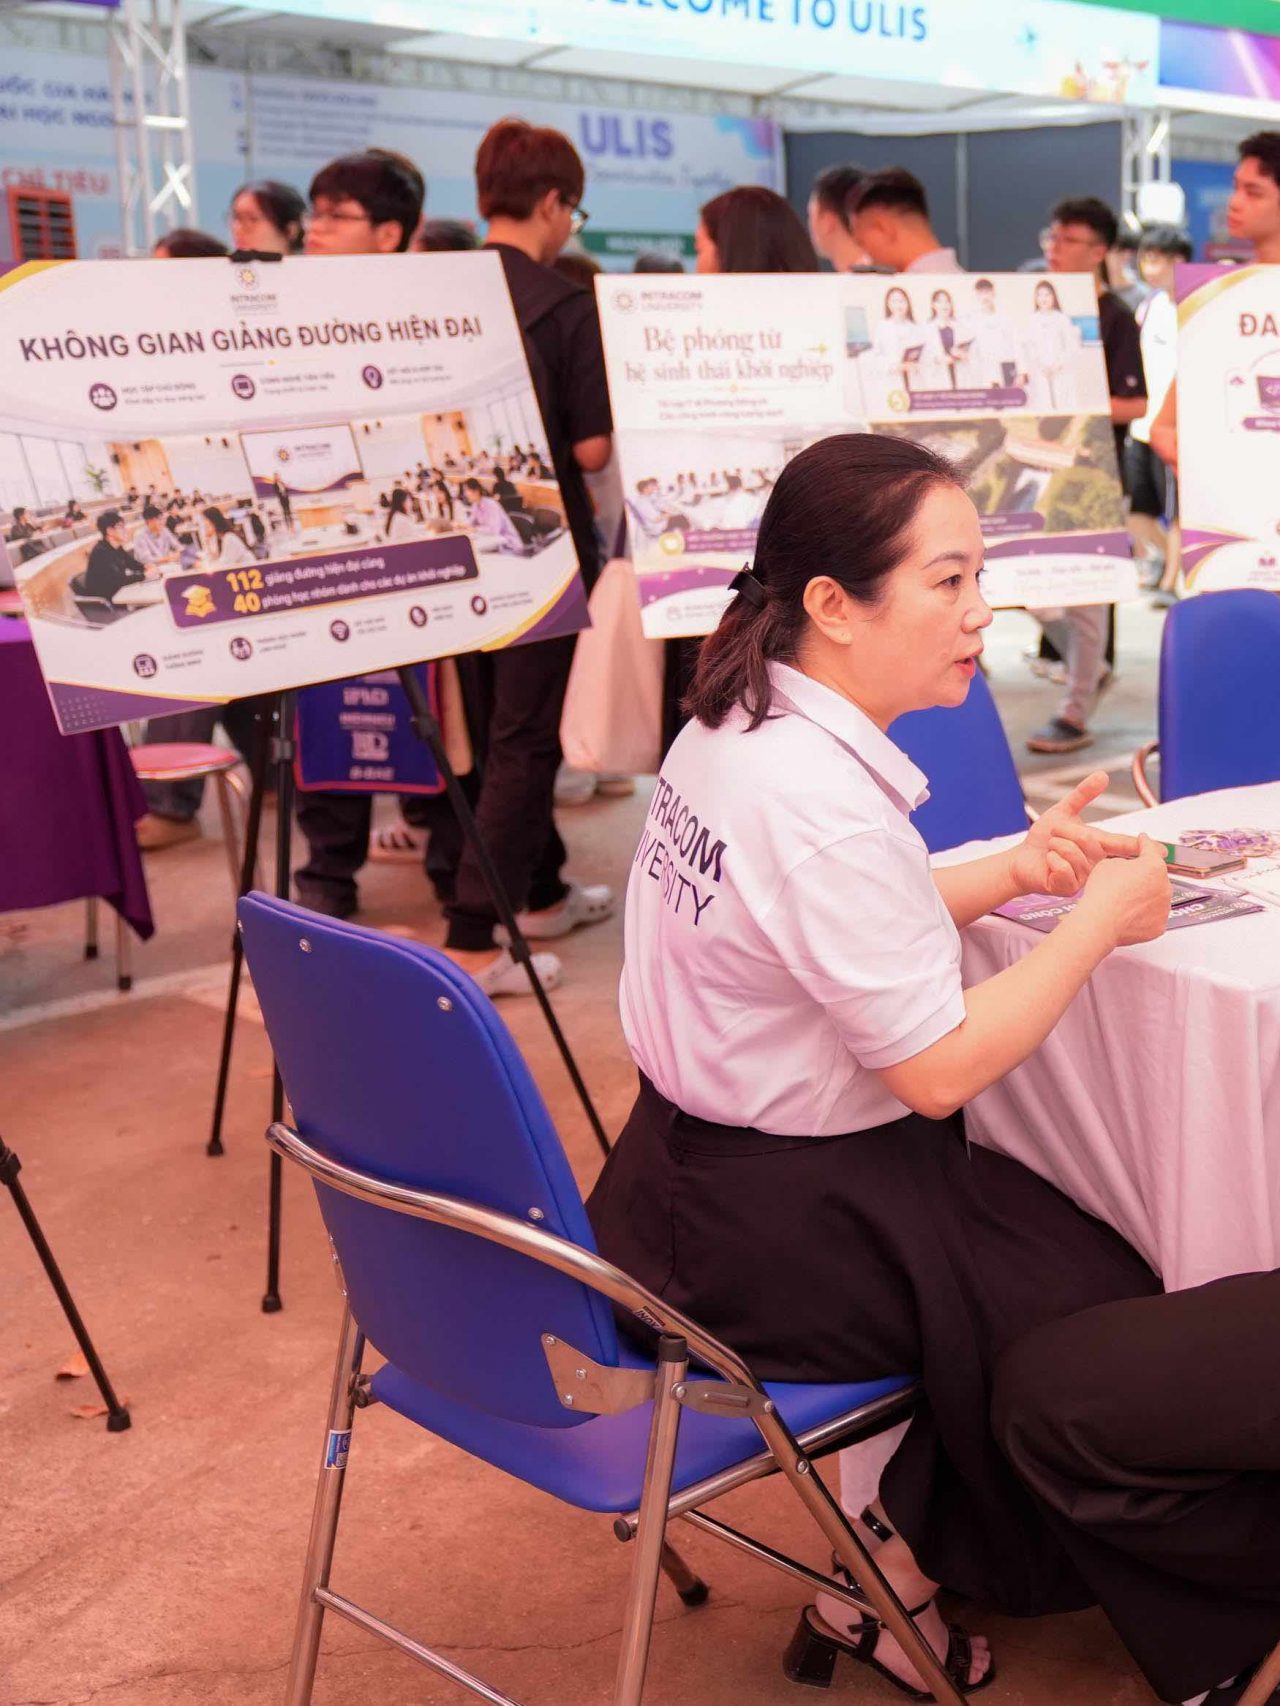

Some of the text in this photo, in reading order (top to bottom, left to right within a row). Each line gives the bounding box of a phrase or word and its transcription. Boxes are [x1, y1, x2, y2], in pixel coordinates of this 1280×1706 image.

[850, 2, 927, 41] ULIS
[578, 112, 674, 159] ULIS
[18, 313, 483, 361] KHÔNG GIAN GIẢNG ĐƯỜNG HIỆN ĐẠI
[1239, 313, 1279, 338] ĐA
[644, 326, 676, 356] Bệ
[683, 326, 754, 359] phóng
[626, 361, 647, 384] hệ
[654, 361, 691, 381] sinh
[698, 359, 731, 381] thái
[778, 356, 834, 383] nghiệp
[226, 569, 264, 592] 112
[265, 571, 294, 587] giảng
[294, 567, 326, 580] đường
[323, 560, 345, 576] hiện
[233, 592, 261, 613] 40
[262, 594, 293, 609] phòng
[651, 777, 727, 882] TRACOM
